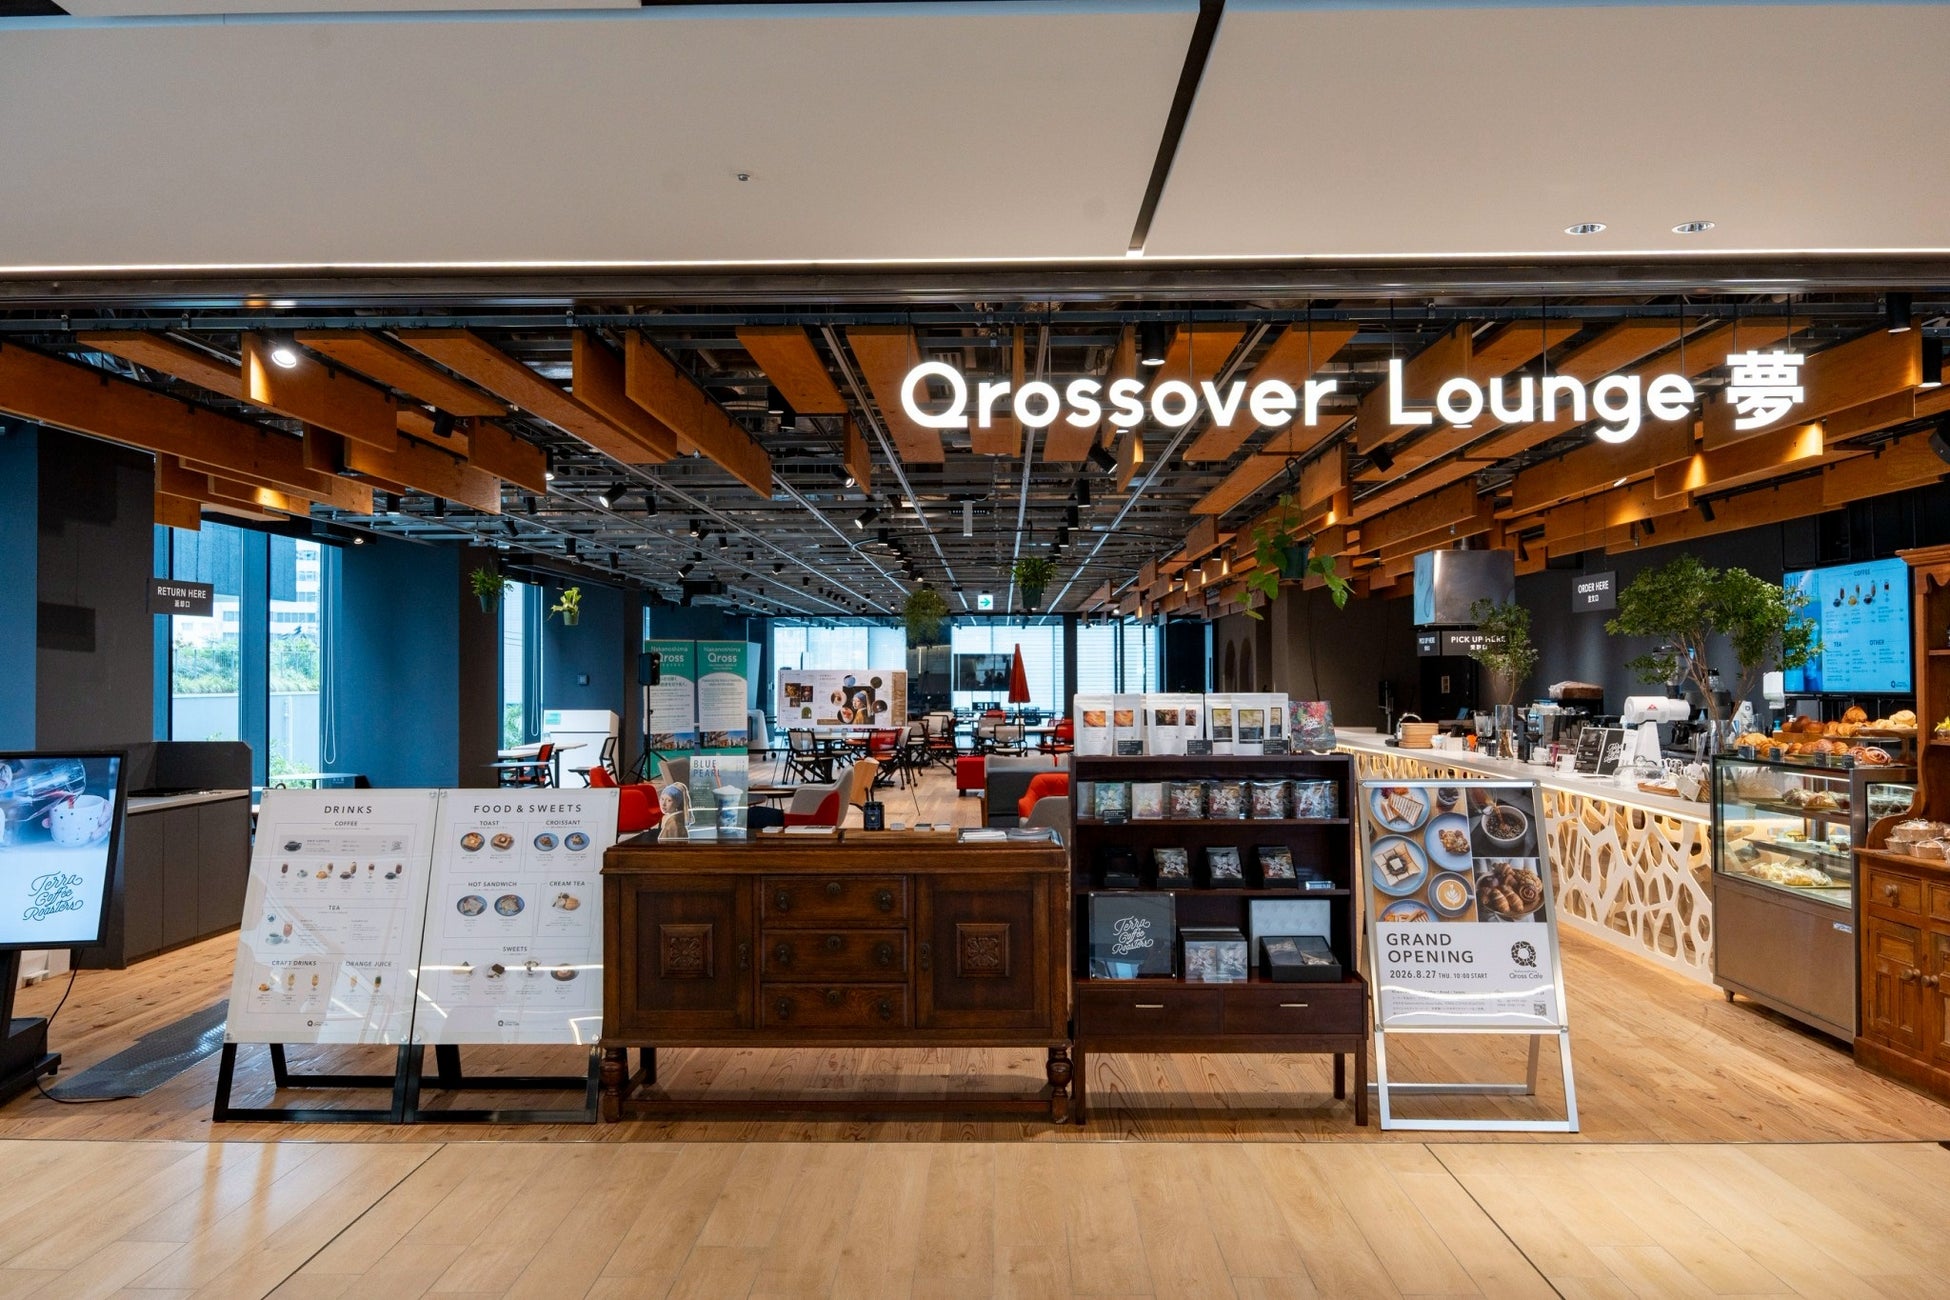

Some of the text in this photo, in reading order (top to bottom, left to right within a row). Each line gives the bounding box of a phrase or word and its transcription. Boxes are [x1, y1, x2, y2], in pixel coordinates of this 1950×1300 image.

[900, 351, 1804, 443] Qrossover Lounge 夢
[157, 586, 206, 599] RETURN HERE
[1578, 580, 1608, 594] ORDER HERE
[708, 652, 737, 663] Qross
[694, 760, 716, 768] BLUE
[324, 805, 373, 814] DRINKS
[474, 804, 582, 814] FOOD & SWEETS
[28, 871, 83, 897] Terra
[34, 886, 74, 907] Coffee
[22, 899, 84, 921] Roasters
[1112, 916, 1150, 936] Terra
[1386, 933, 1451, 946] GRAND
[1112, 938, 1154, 956] Roasters
[1388, 950, 1474, 963] OPENING
[1390, 970, 1436, 978] 2026.8.27
